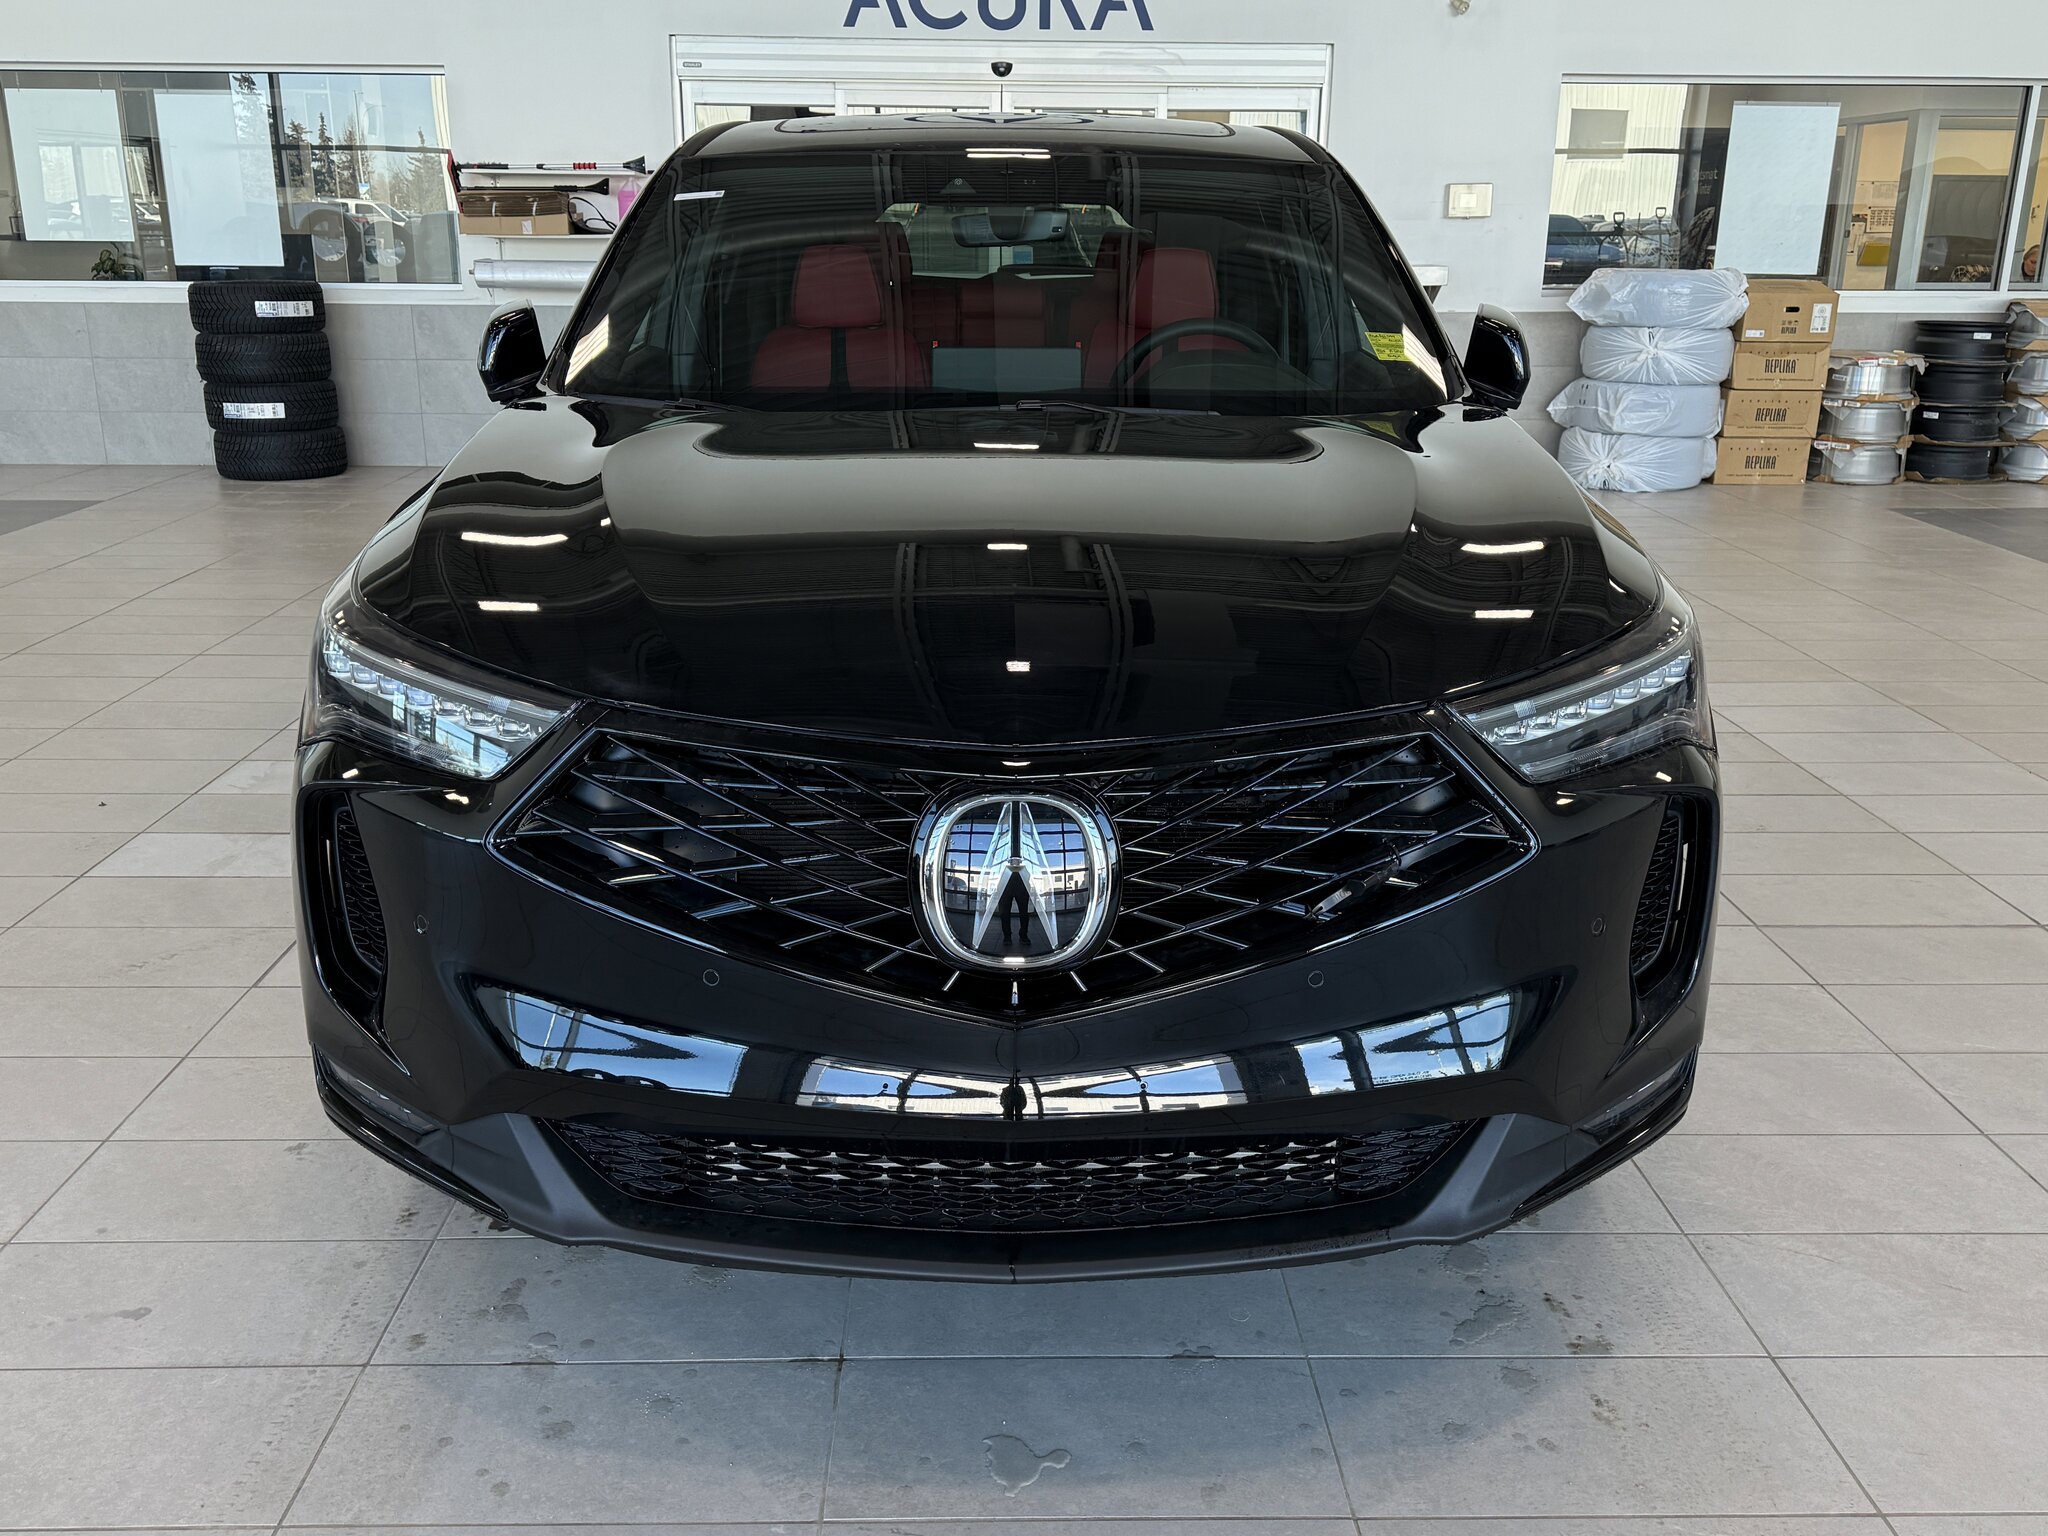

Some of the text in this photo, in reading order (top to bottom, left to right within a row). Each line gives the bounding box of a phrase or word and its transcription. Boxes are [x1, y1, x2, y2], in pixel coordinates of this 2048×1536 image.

[1765, 359, 1797, 374] REPLIKA
[1755, 407, 1788, 422] REPLIKA
[1745, 455, 1777, 470] REPLIKA
